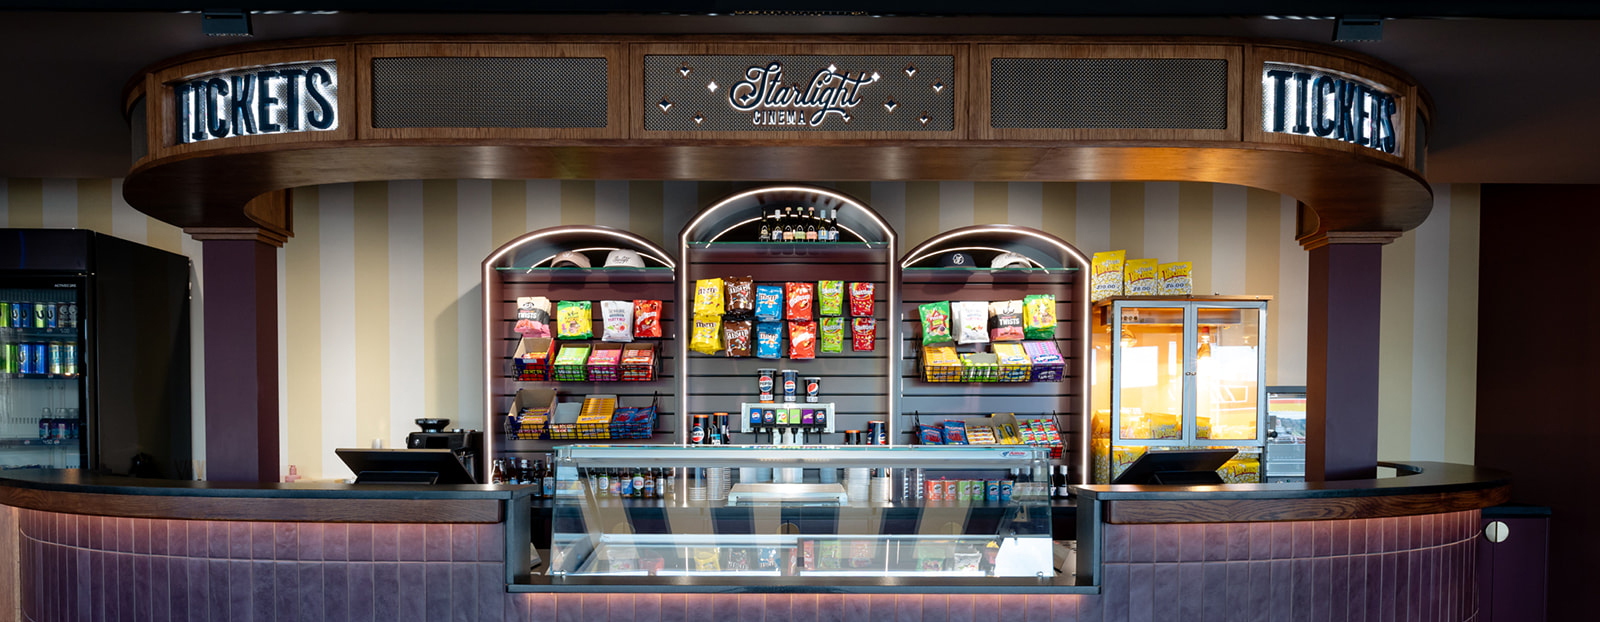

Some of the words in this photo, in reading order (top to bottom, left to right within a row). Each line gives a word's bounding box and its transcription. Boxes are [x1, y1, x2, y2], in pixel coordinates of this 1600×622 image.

[174, 66, 335, 144] TICKETS
[729, 61, 873, 127] Starlight
[752, 109, 807, 125] CINEMA
[1267, 69, 1397, 153] TICKETS
